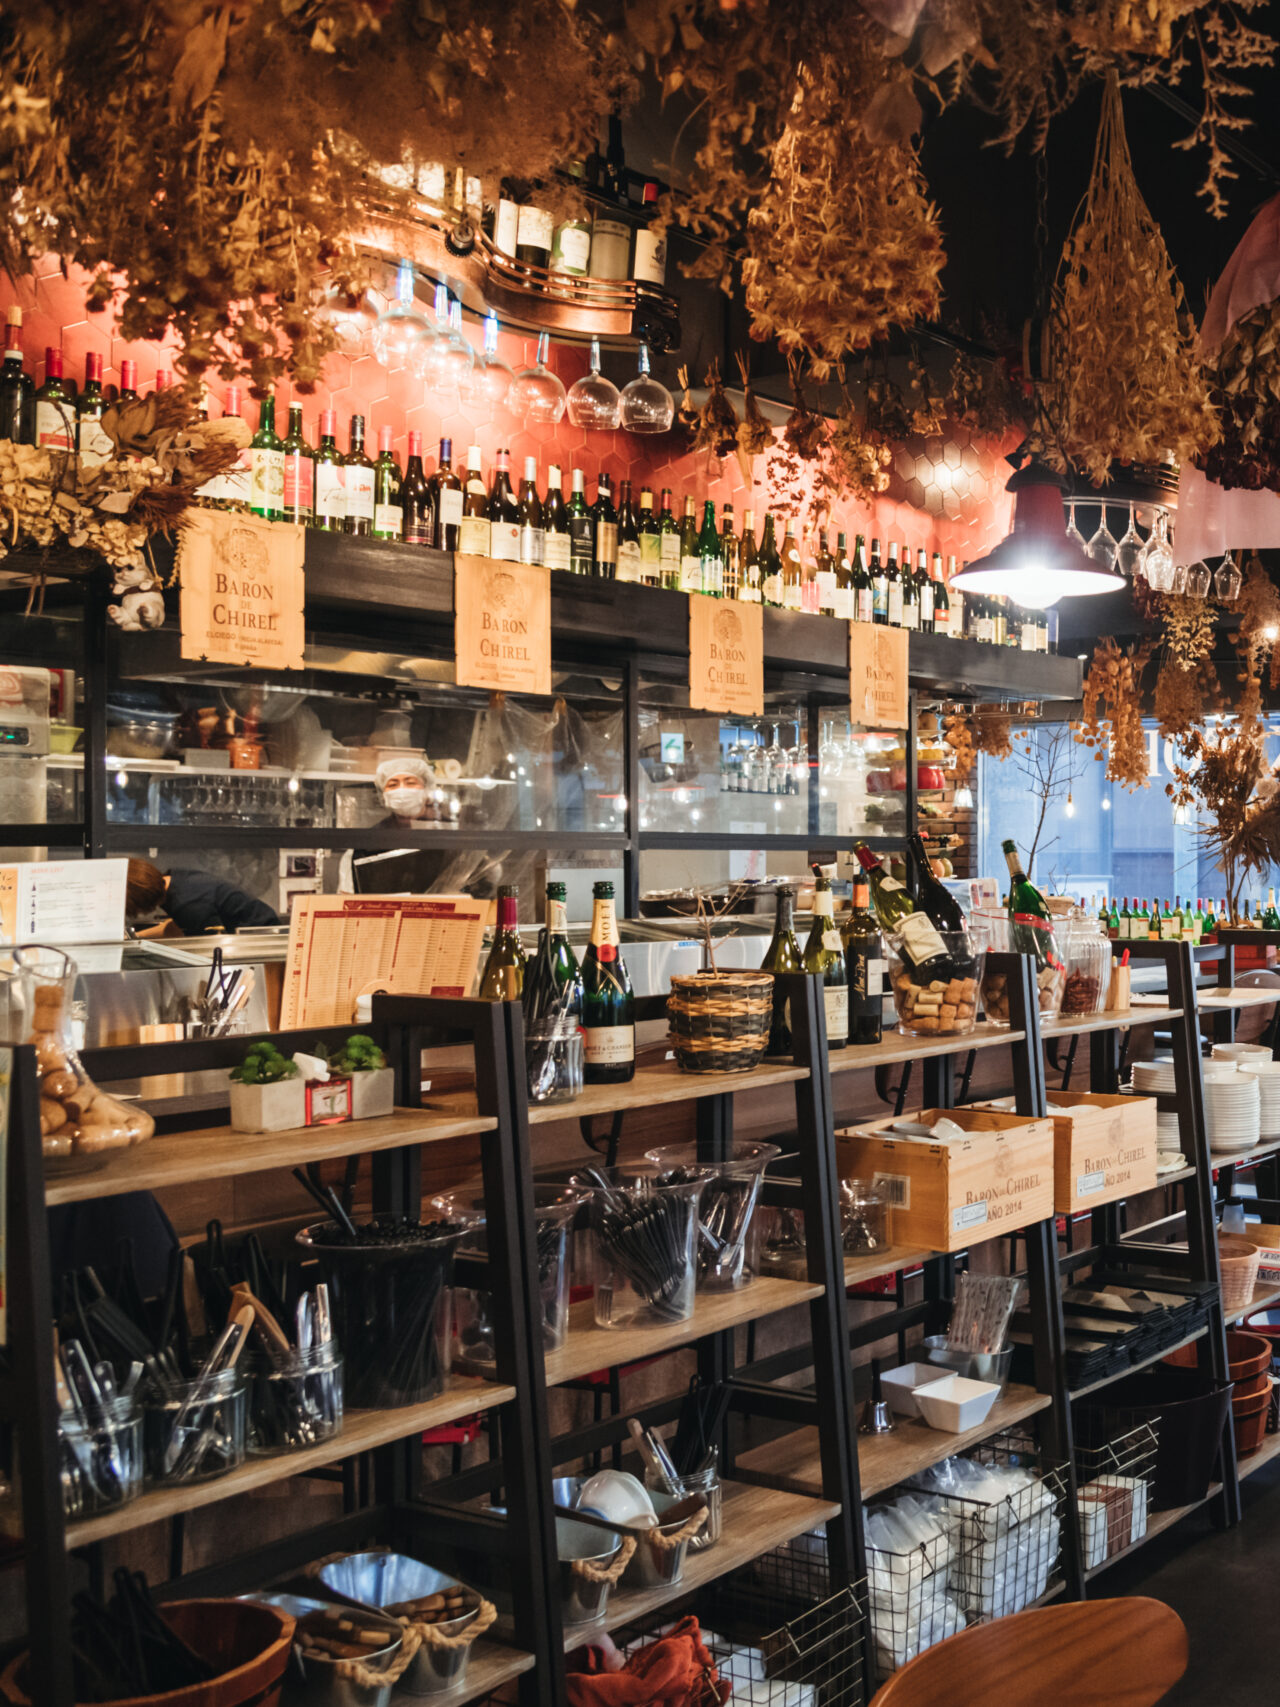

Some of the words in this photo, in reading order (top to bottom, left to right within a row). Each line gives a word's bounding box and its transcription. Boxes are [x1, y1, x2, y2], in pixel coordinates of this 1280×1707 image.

[216, 573, 274, 600] BARON
[213, 604, 277, 630] CHIREL
[482, 612, 528, 634] BARON
[480, 638, 531, 661] CHIREL
[710, 644, 746, 662] BARON
[708, 666, 748, 685] CHIREL
[1085, 1157, 1111, 1174] BARON
[1118, 1147, 1146, 1165] CHIREL
[1117, 1170, 1131, 1183] 2014
[966, 1188, 999, 1205] BARON
[1006, 1174, 1041, 1196] CHIREL
[1005, 1200, 1022, 1216] 2014
